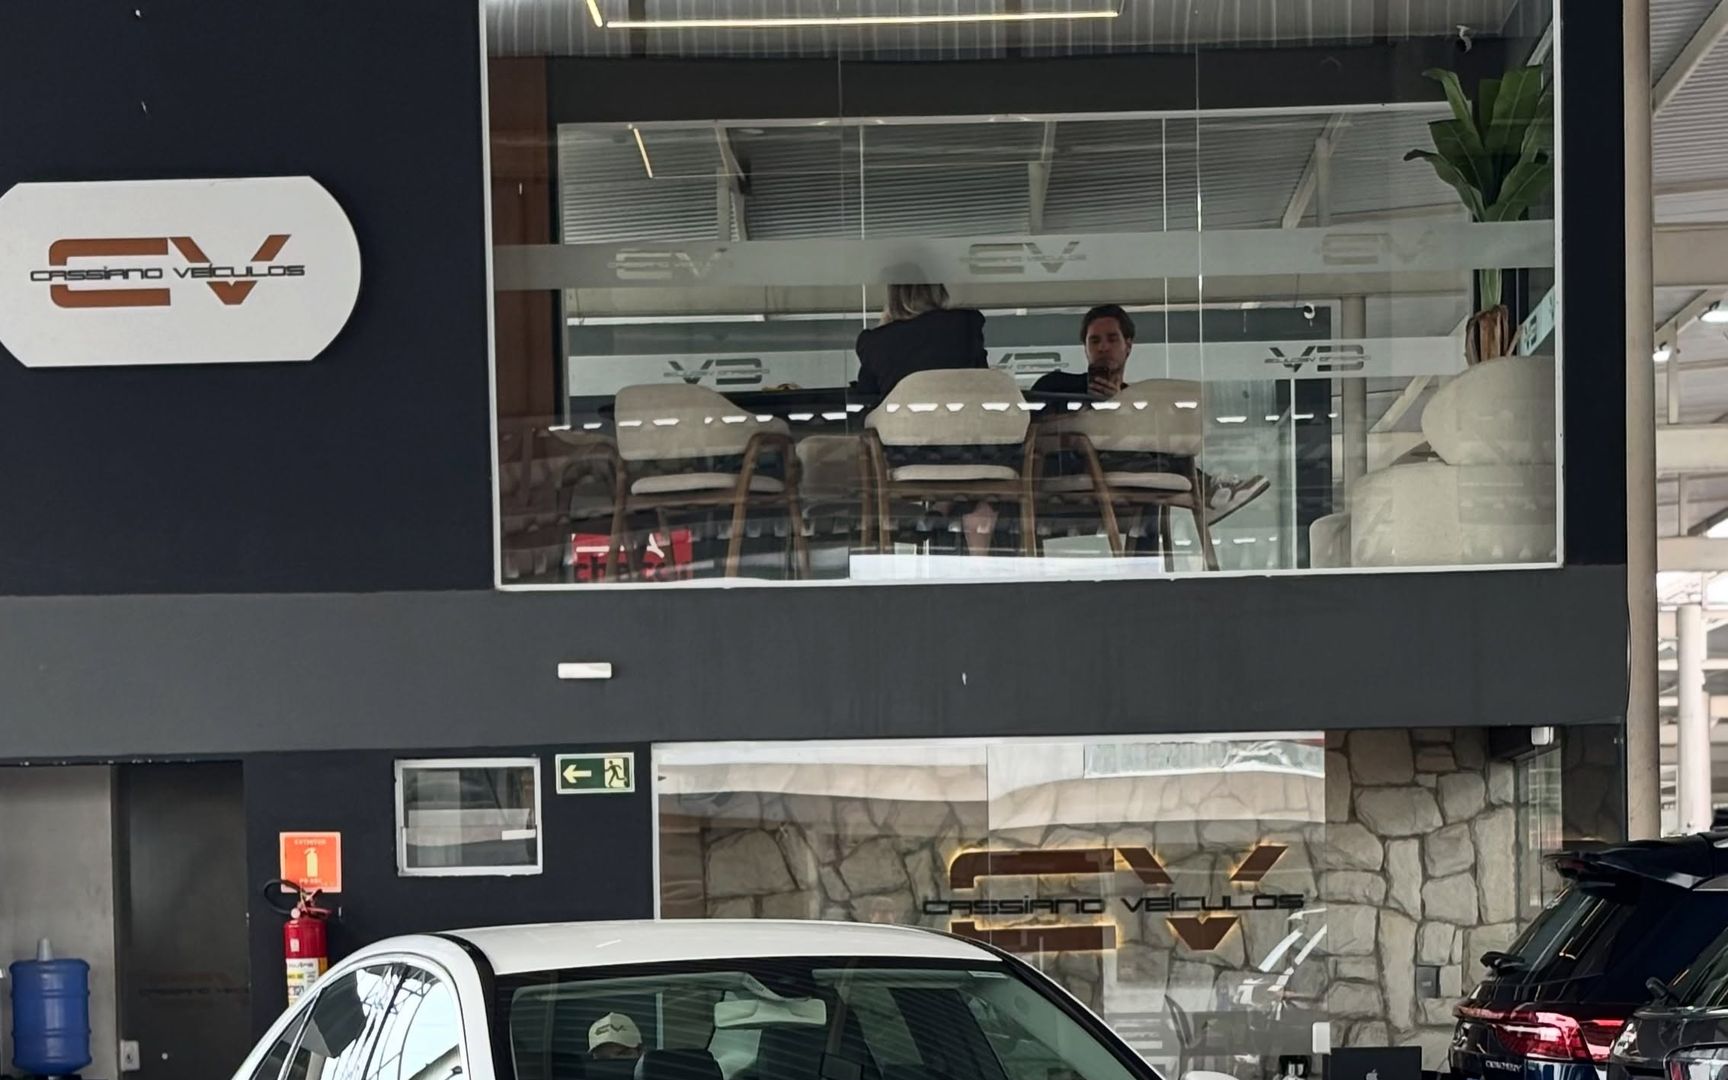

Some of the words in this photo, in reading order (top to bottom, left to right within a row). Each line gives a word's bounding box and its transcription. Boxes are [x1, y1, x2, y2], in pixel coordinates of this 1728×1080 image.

[31, 266, 163, 281] CASSIANO
[173, 263, 305, 279] VEÍCULOS
[49, 234, 292, 308] CV
[922, 895, 1105, 915] CASSIANO
[1120, 892, 1304, 912] VEÍCULOS
